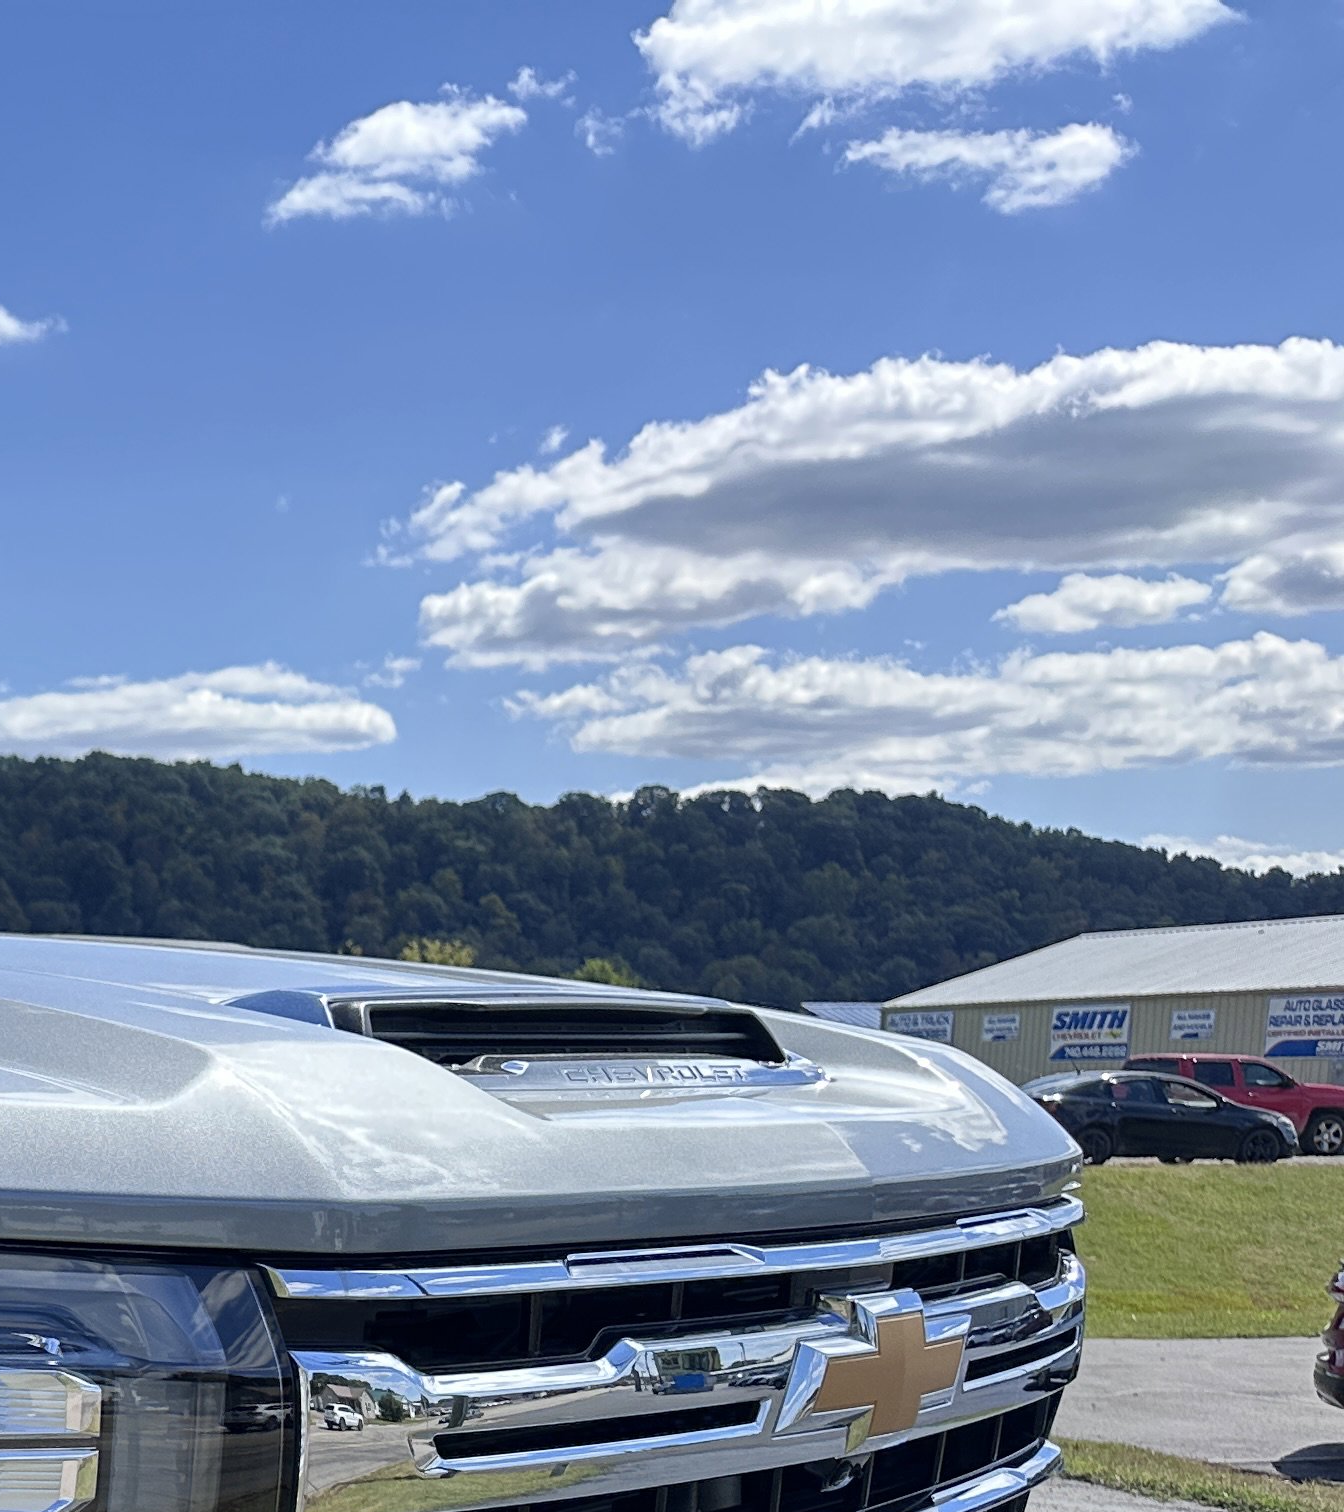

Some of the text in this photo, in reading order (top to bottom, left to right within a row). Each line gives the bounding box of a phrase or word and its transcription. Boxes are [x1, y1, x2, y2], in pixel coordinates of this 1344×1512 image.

[1284, 1000, 1311, 1012] AUTO
[1052, 1008, 1128, 1030] SMITH
[1269, 1014, 1302, 1027] REPAIR
[1053, 1031, 1101, 1041] CHEVROLET
[560, 1064, 744, 1084] CHEVROLET
